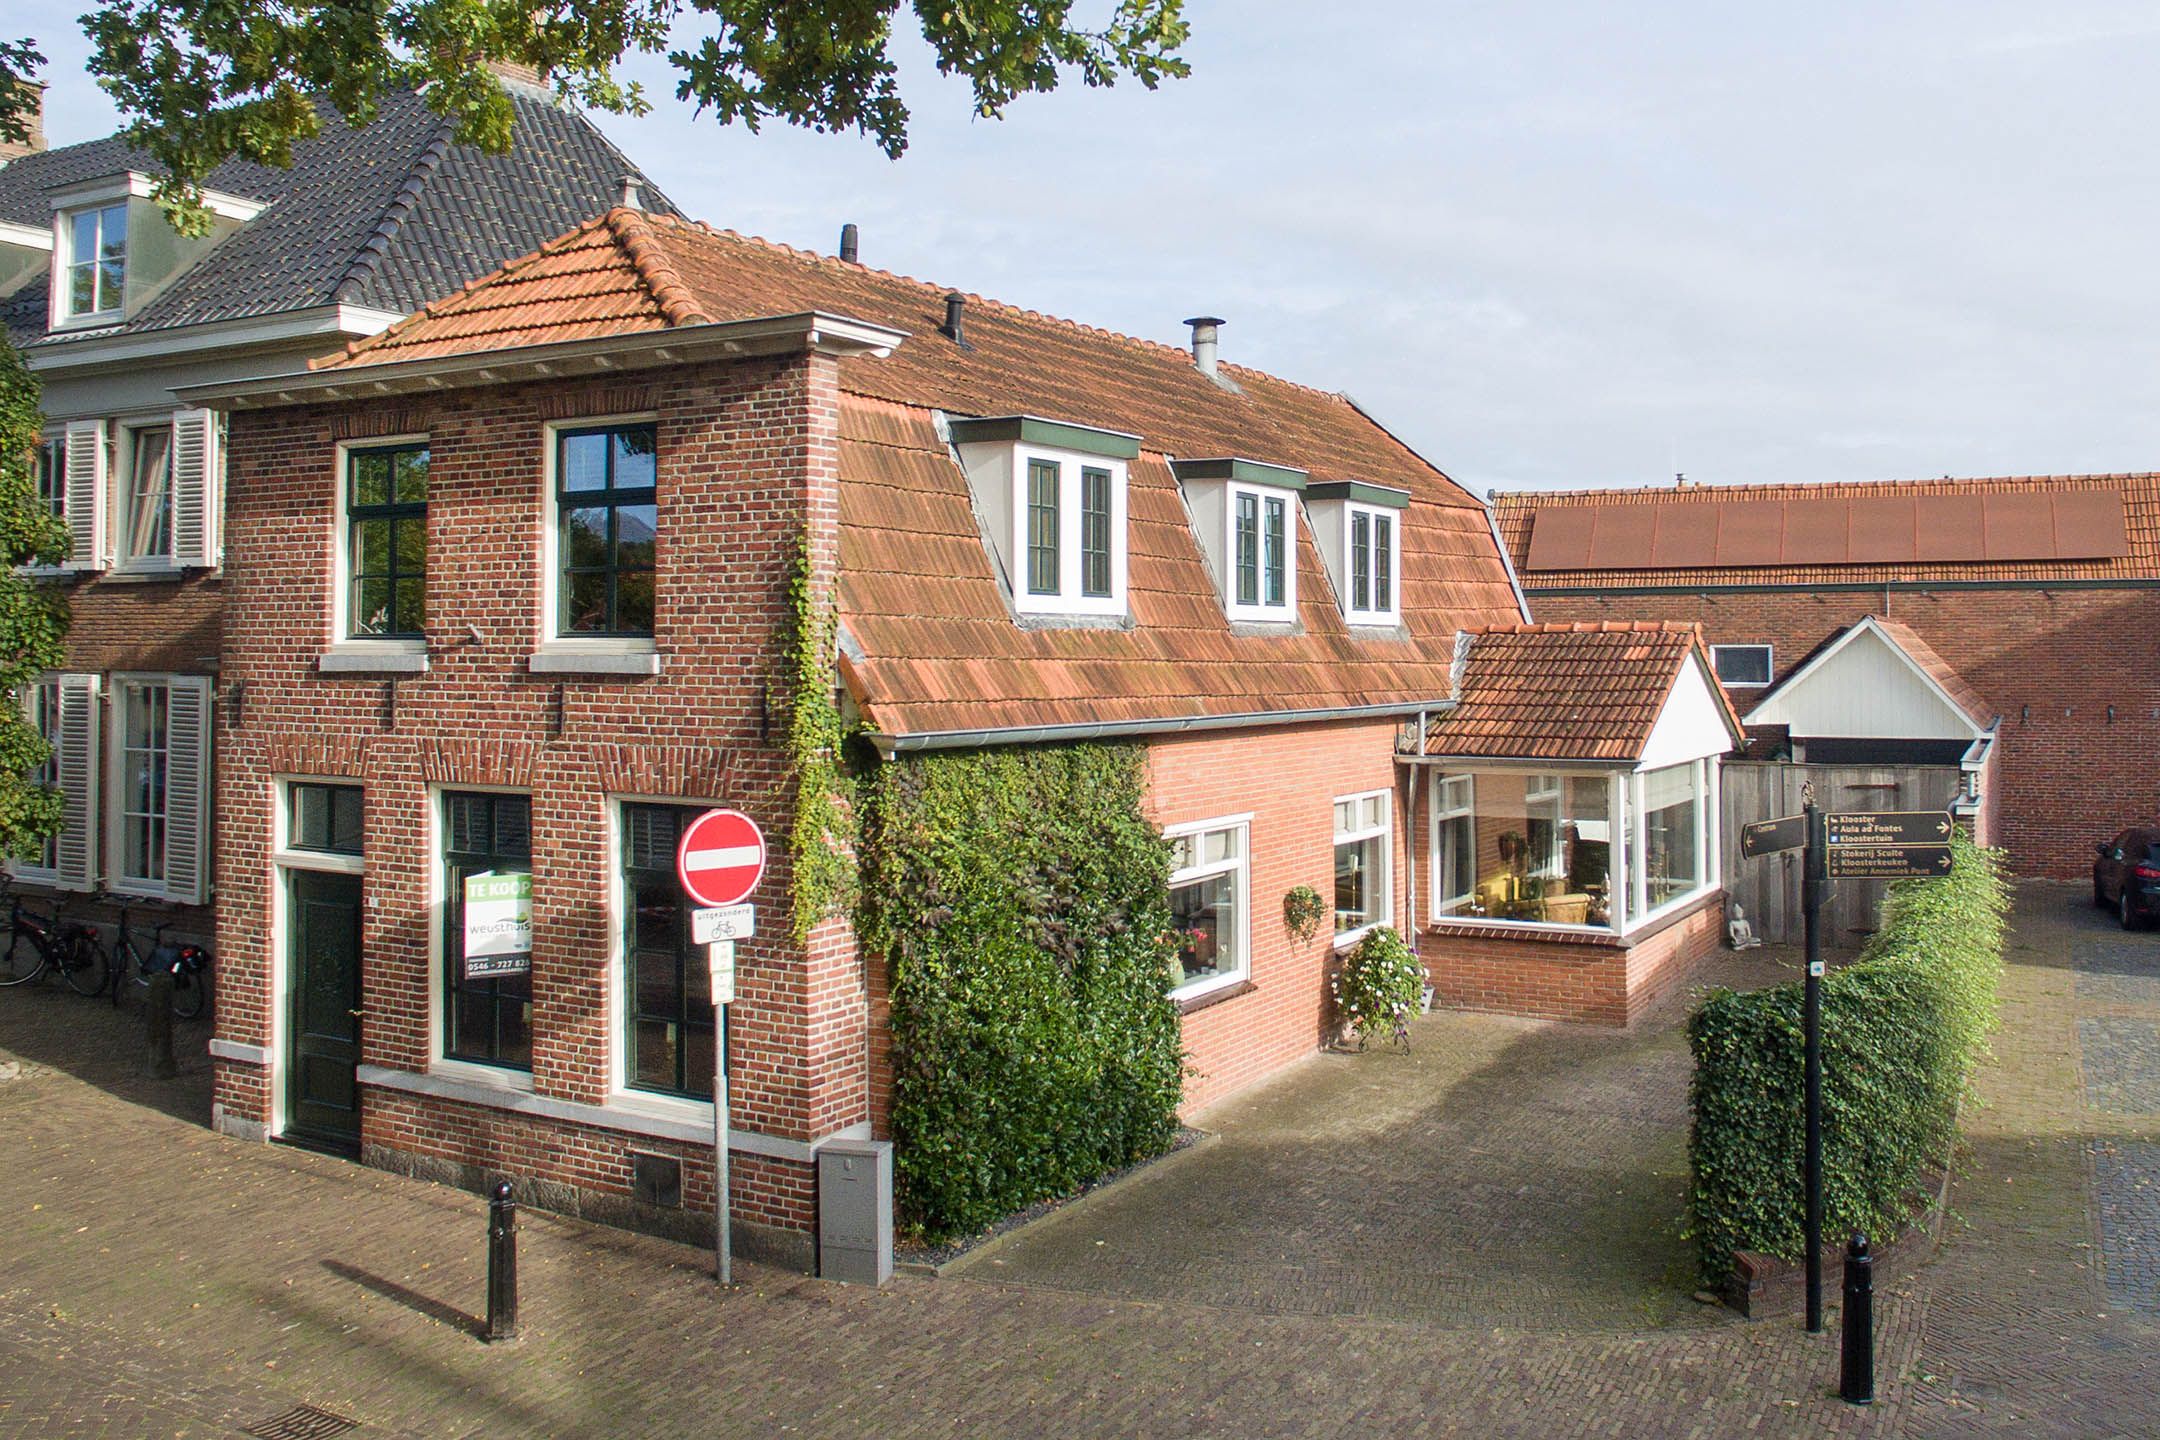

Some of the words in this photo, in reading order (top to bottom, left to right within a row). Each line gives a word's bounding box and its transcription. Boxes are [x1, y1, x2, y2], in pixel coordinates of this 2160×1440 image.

[1839, 815, 1876, 823] Klooster
[1840, 825, 1859, 833] Aula
[1861, 825, 1872, 833] ad
[1874, 824, 1904, 832] Fontes
[1839, 834, 1893, 842] Kloostertuin
[1840, 849, 1875, 859] Stokerij
[1877, 849, 1904, 857] Sculte
[1840, 858, 1908, 866] Kloosterkeuken
[468, 884, 487, 898] TE
[489, 881, 530, 897] KOOP
[697, 908, 751, 920] uitgezonderd
[470, 920, 530, 934] weusthuis
[468, 962, 489, 972] 0546
[496, 960, 513, 969] 727
